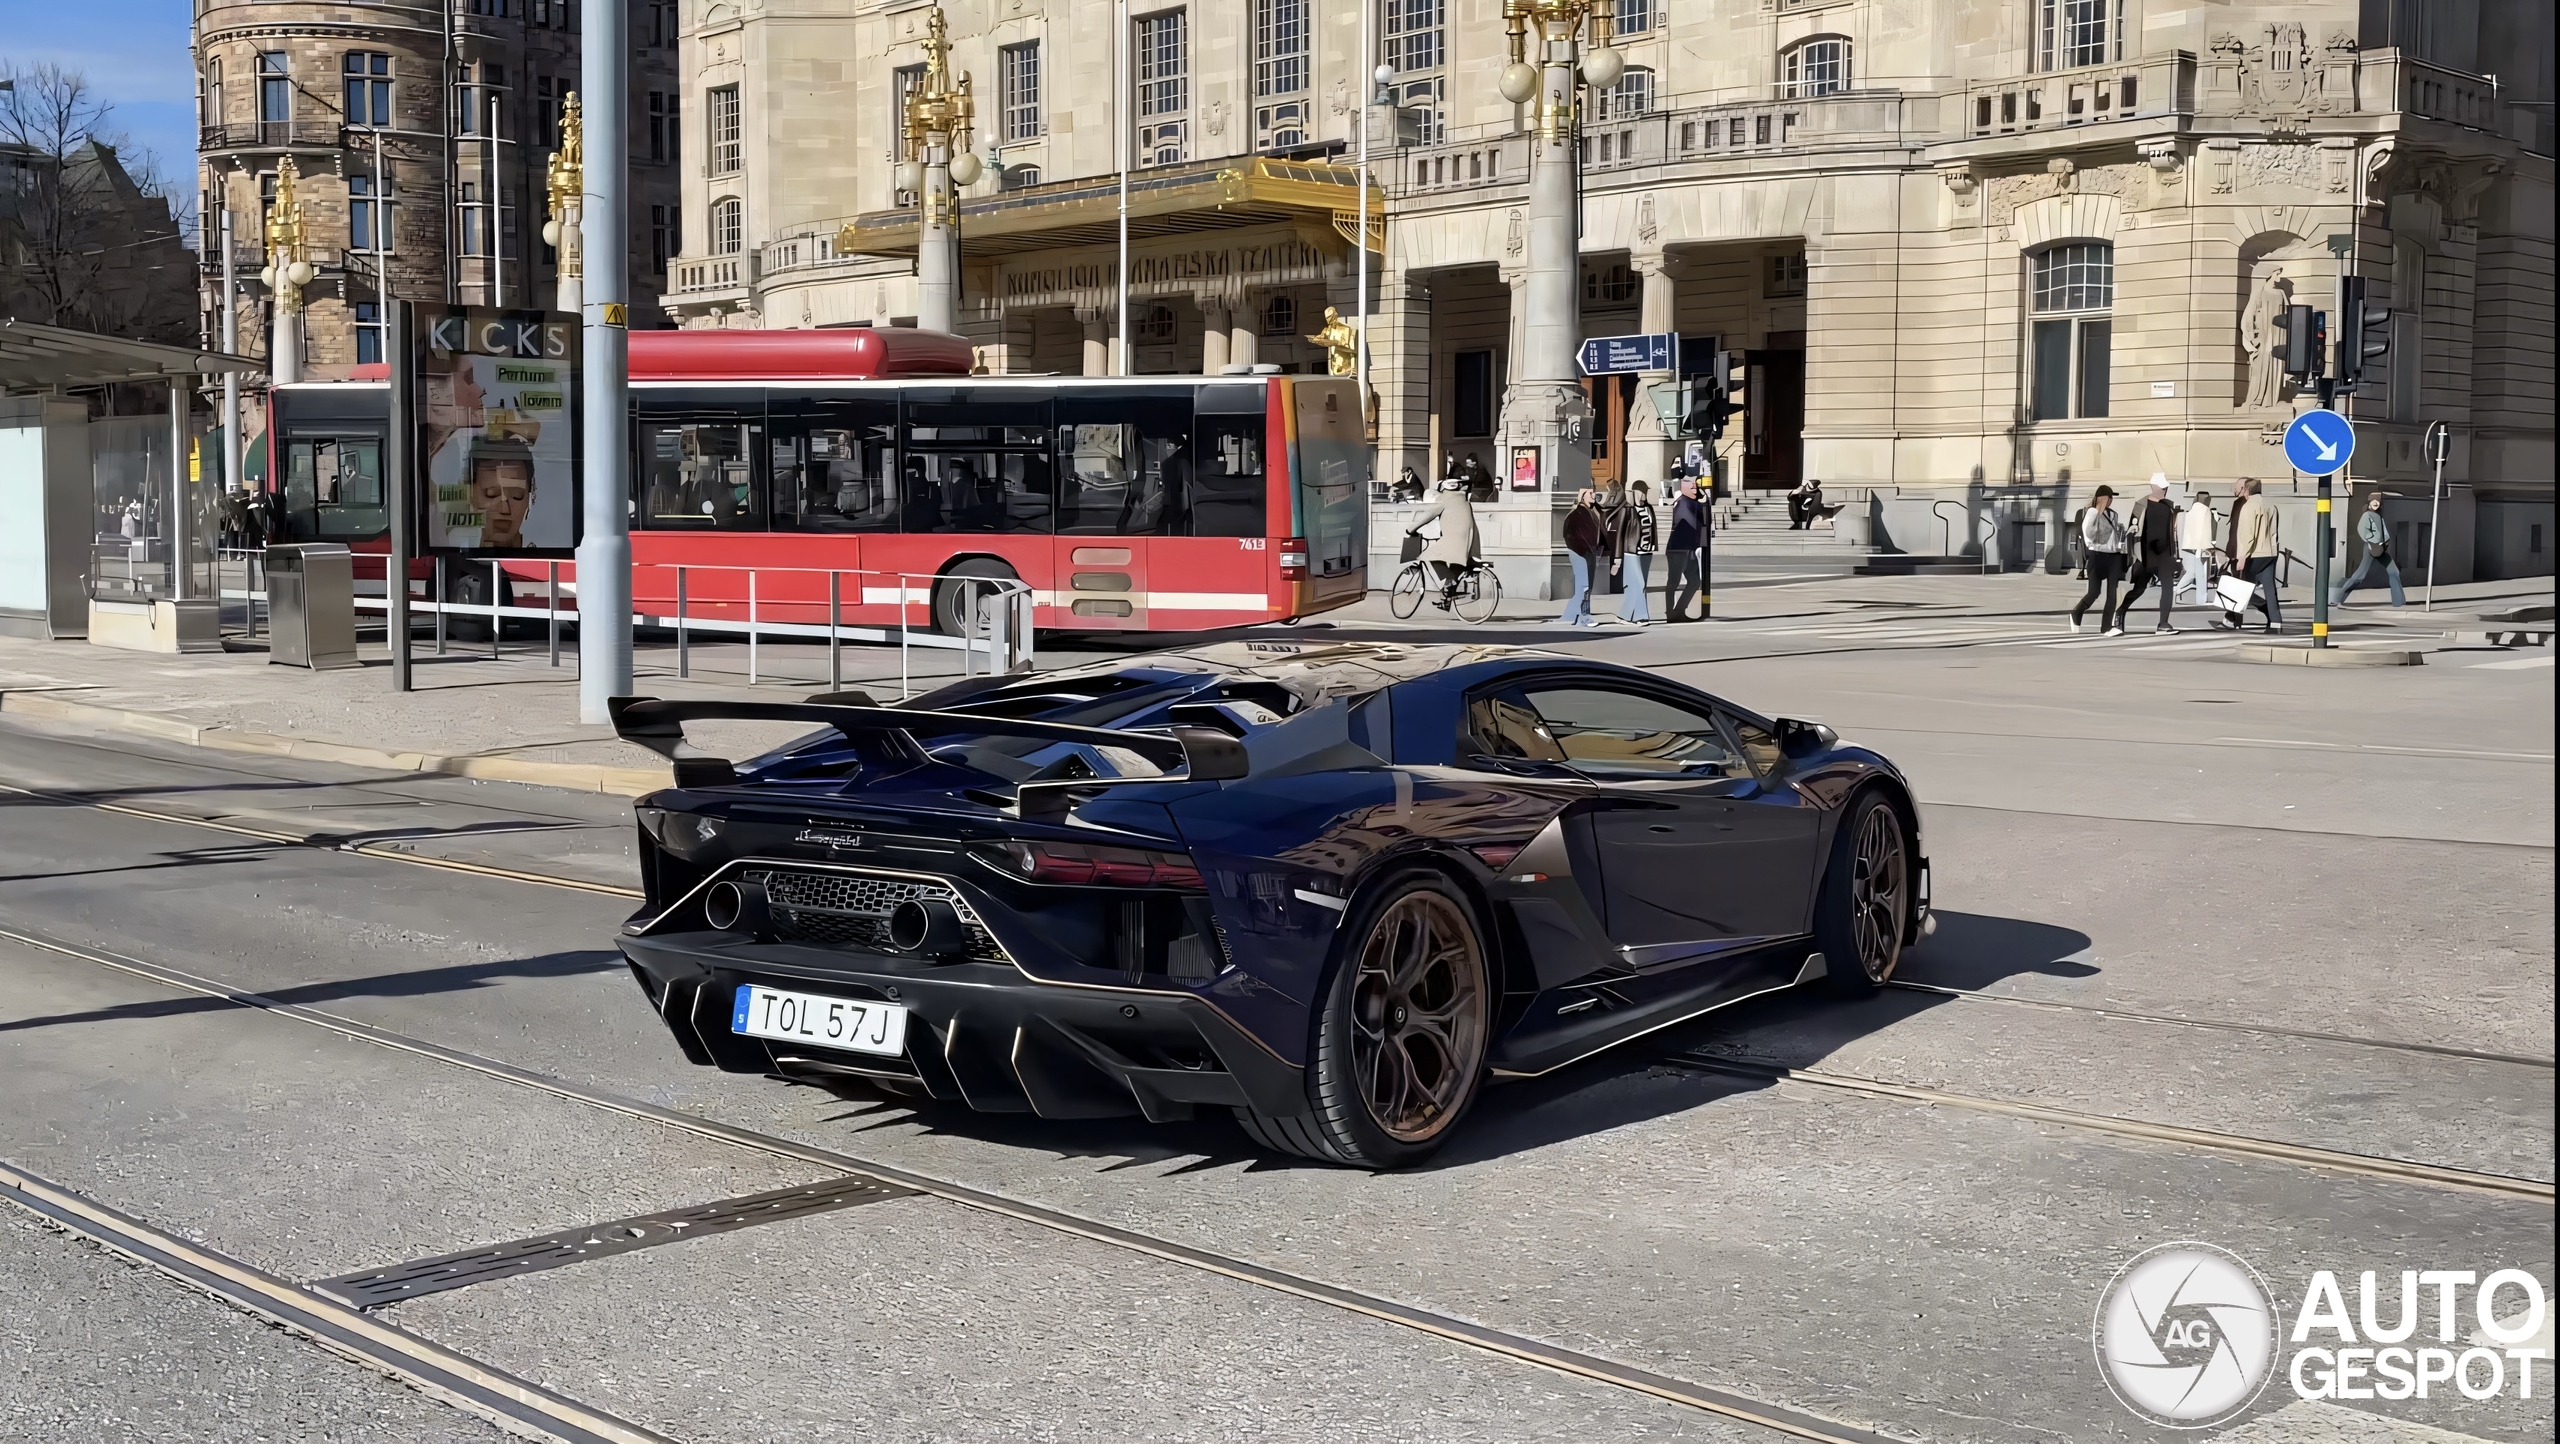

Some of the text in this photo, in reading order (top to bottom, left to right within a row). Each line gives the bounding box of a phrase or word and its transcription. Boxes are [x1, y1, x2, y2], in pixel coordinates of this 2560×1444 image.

[430, 317, 565, 356] KICKS
[762, 994, 889, 1045] TOL 57J
